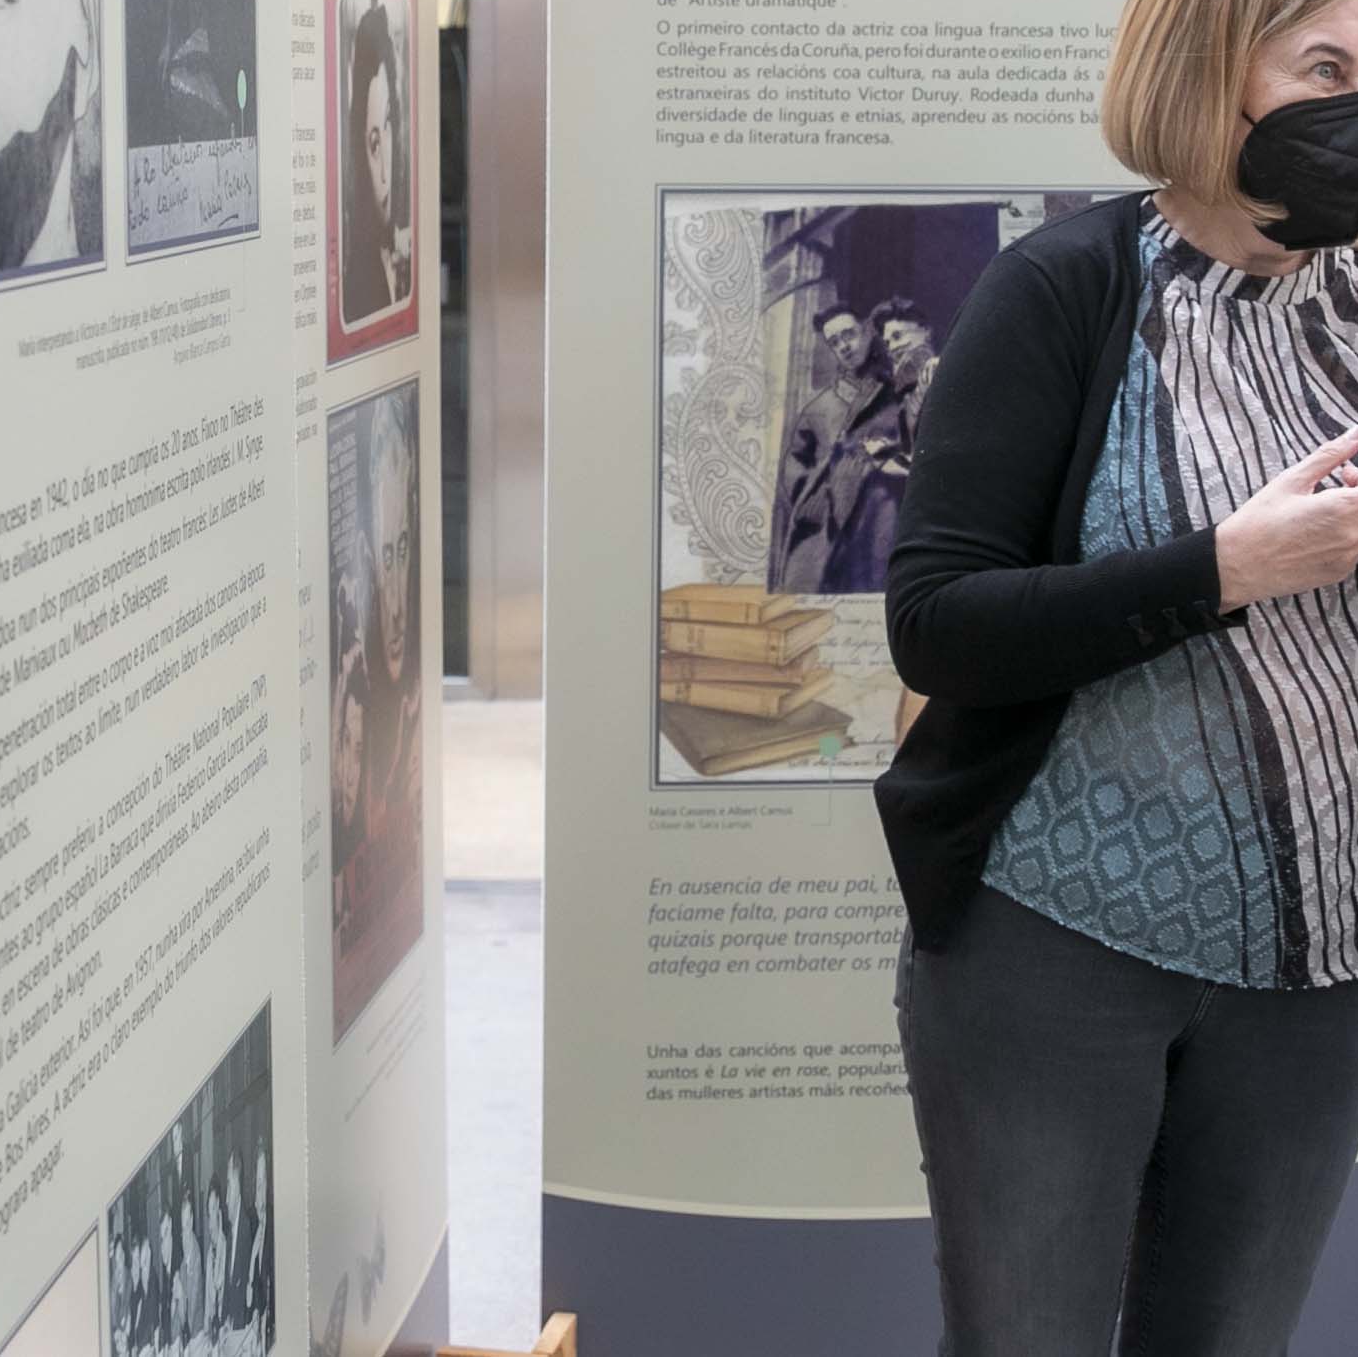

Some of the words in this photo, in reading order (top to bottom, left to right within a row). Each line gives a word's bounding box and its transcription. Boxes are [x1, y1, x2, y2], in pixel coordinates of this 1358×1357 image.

[655, 127, 705, 148] lingua
[709, 132, 720, 144] e
[723, 129, 744, 144] da
[748, 128, 820, 145] literatura
[824, 128, 893, 145] francesa.
[648, 877, 672, 896] En
[677, 875, 763, 895] ausencia
[767, 875, 792, 894] de
[796, 879, 840, 894] meu
[842, 873, 879, 898] pai,
[647, 902, 725, 925] faciame
[729, 901, 777, 924] falta,
[782, 905, 828, 925] para
[647, 929, 715, 953] quizais
[718, 932, 788, 952] porque
[647, 954, 721, 978] atafega
[726, 959, 750, 974] en
[754, 953, 847, 973] combater
[850, 956, 872, 971] os
[646, 1043, 688, 1060] Unha
[694, 1042, 722, 1058] das
[728, 1041, 797, 1058] cancións
[802, 1044, 834, 1060] que
[646, 1066, 699, 1080] xuntos
[703, 1064, 715, 1079] é
[720, 1064, 739, 1080] La
[744, 1063, 767, 1079] vie
[771, 1065, 791, 1078] en
[796, 1064, 831, 1078] rose,
